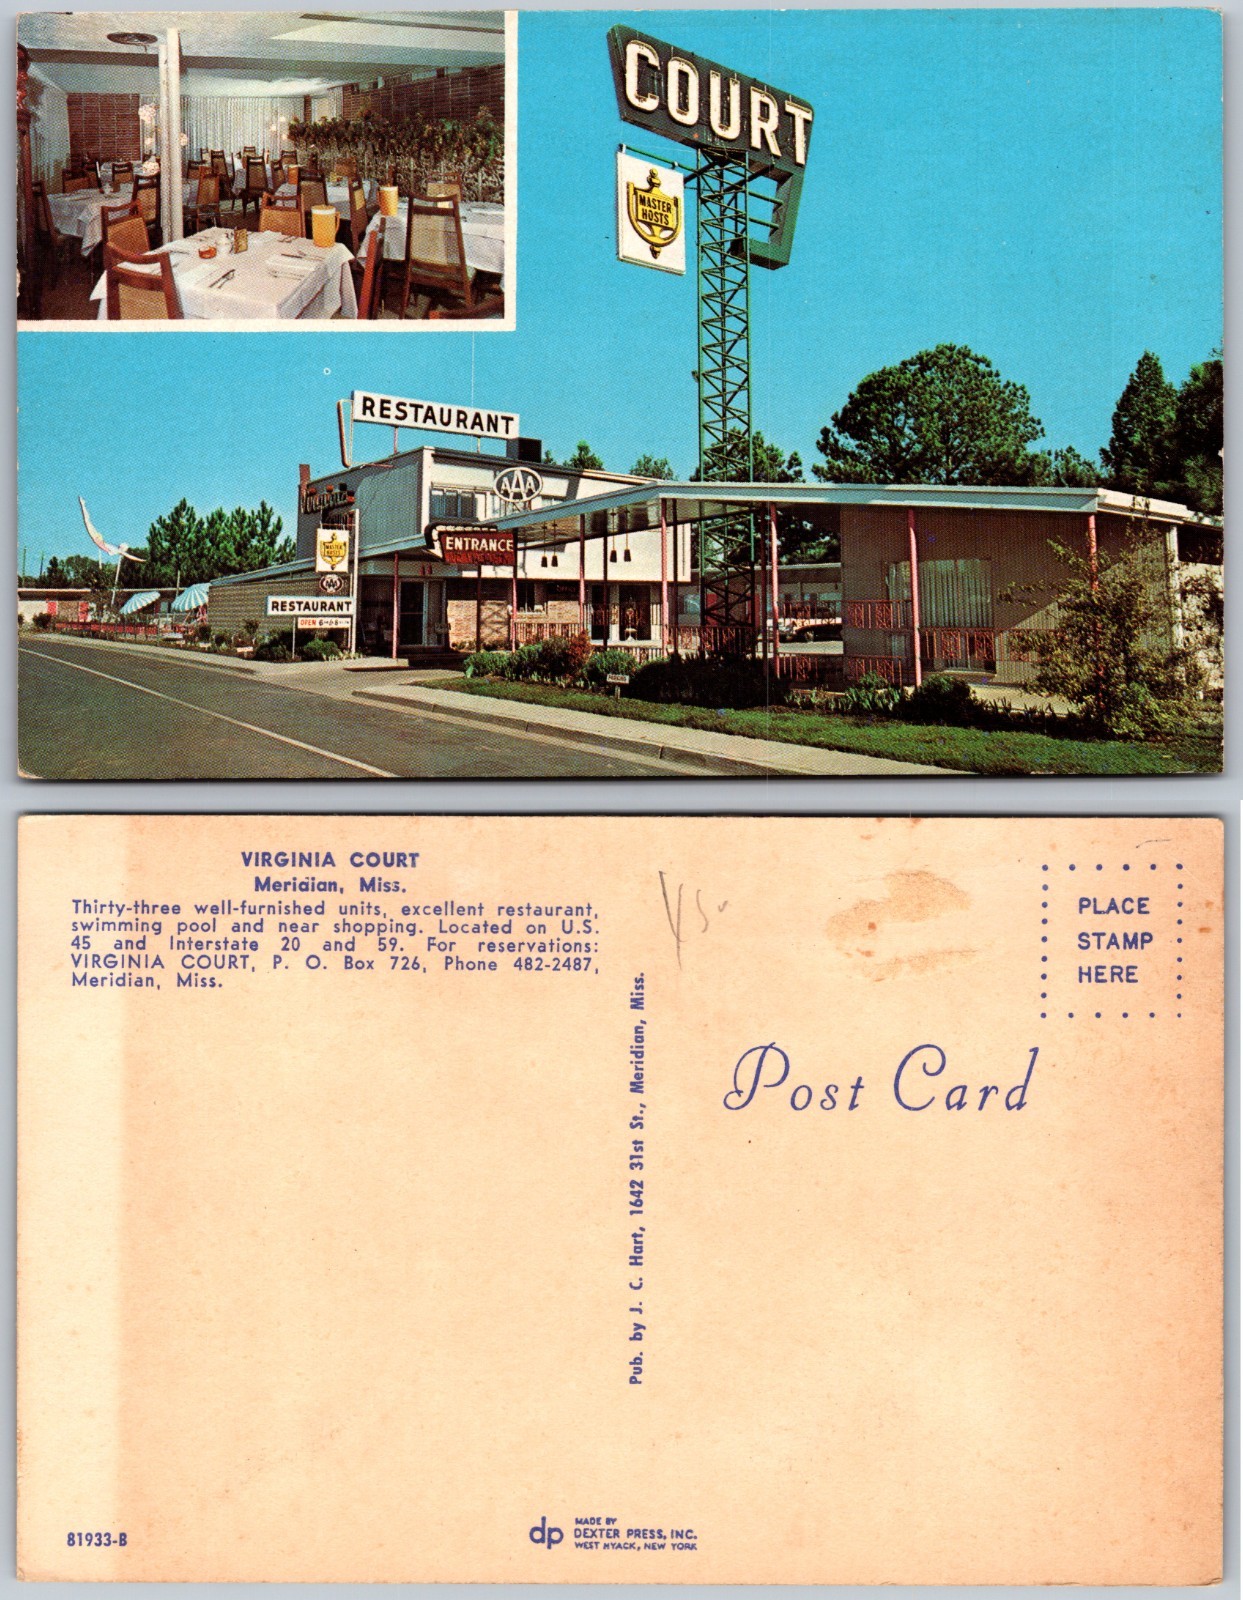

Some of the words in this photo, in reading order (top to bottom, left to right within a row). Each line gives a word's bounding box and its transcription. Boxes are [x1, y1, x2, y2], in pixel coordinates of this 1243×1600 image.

[625, 39, 813, 167] COURT
[639, 194, 672, 213] MASTER
[641, 207, 670, 225] HOSTS
[361, 395, 515, 435] RESTAURANT
[500, 470, 537, 500] AAA
[445, 536, 514, 552] ENTRANCE
[271, 600, 352, 612] RESTAURANT
[300, 619, 317, 627] OPEN
[241, 851, 336, 868] VIRGINIA
[349, 851, 420, 868] COURT
[254, 876, 344, 894] Meridian,
[359, 876, 407, 893] Miss.
[72, 899, 181, 919] Thirty-three
[194, 900, 325, 918] well-furnished
[338, 901, 389, 919] units,
[400, 901, 485, 918] excellent
[496, 902, 599, 920] restaurant,
[1078, 896, 1150, 915] PLACE
[71, 918, 162, 936] swimming
[177, 918, 217, 937] pool
[231, 918, 264, 933] and
[278, 921, 320, 934] near
[333, 919, 424, 938] shopping.
[438, 919, 512, 935] Located
[526, 923, 547, 935] on
[560, 918, 600, 935] U.S.
[70, 935, 91, 951] 45
[113, 935, 147, 951] and
[169, 936, 259, 952] Interstate
[280, 936, 301, 952] 20
[322, 935, 356, 952] and
[377, 936, 405, 952] 59.
[427, 936, 456, 952] For
[478, 937, 599, 953] reservations:
[1077, 931, 1153, 951] STAMP
[70, 953, 165, 969] VIRGINIA
[181, 954, 257, 972] COURT,
[273, 954, 289, 969] P.
[305, 954, 328, 970] O.
[344, 955, 374, 971] Box
[390, 955, 427, 973] 726,
[444, 955, 497, 971] Phone
[513, 956, 599, 974] 482-2487,
[72, 971, 161, 989] Meridian,
[176, 972, 223, 988] Miss.
[1078, 965, 1137, 984] HERE
[629, 972, 645, 1011] Miss.
[629, 1019, 647, 1094] Meridian,
[723, 1041, 865, 1111] Post
[893, 1043, 1040, 1112] Card
[629, 1102, 647, 1130] St.,
[629, 1139, 644, 1171] 31st
[628, 1179, 644, 1216] 1642
[628, 1226, 646, 1267] Hart,
[628, 1276, 643, 1291] C.
[628, 1301, 643, 1315] J.
[628, 1322, 647, 1342] by
[628, 1351, 643, 1385] Pub.
[574, 1517, 602, 1526] MADE
[605, 1517, 618, 1526] BY
[66, 1531, 128, 1548] 81933-B
[529, 1515, 564, 1550] dp
[573, 1527, 620, 1539] DEXTER
[626, 1528, 667, 1541] PRESS,
[670, 1529, 698, 1541] INC.
[574, 1541, 601, 1550] WEST
[603, 1541, 641, 1552] NYACK,
[643, 1542, 666, 1551] NEW
[671, 1542, 698, 1551] YORK
